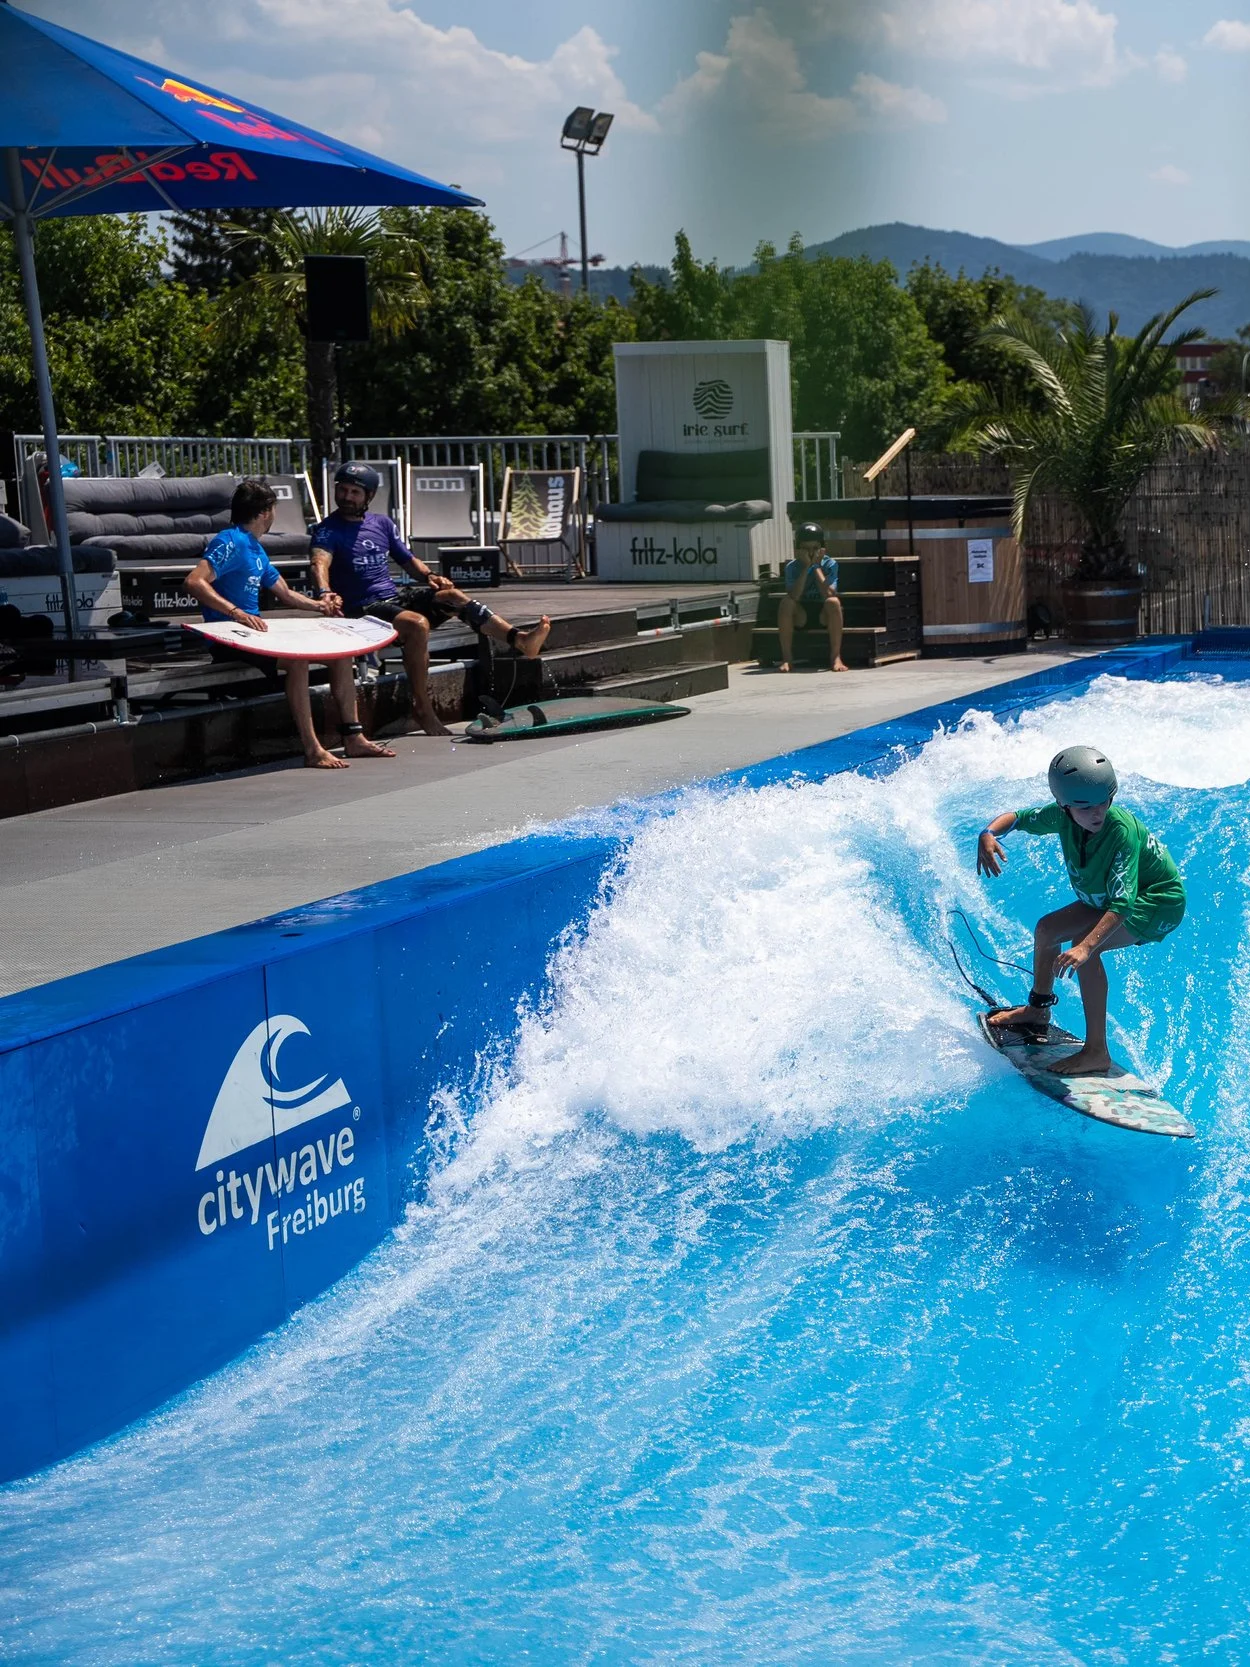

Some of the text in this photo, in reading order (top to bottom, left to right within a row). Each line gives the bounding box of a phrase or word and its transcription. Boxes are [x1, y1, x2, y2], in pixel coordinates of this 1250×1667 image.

[683, 422, 749, 438] irie surf
[629, 536, 718, 566] fritz-kola
[450, 565, 492, 579] fritz-kola
[45, 591, 94, 611] fritzola
[153, 591, 199, 609] fritz-kola
[198, 1126, 355, 1236] citywave
[266, 1177, 366, 1251] Freiburg
